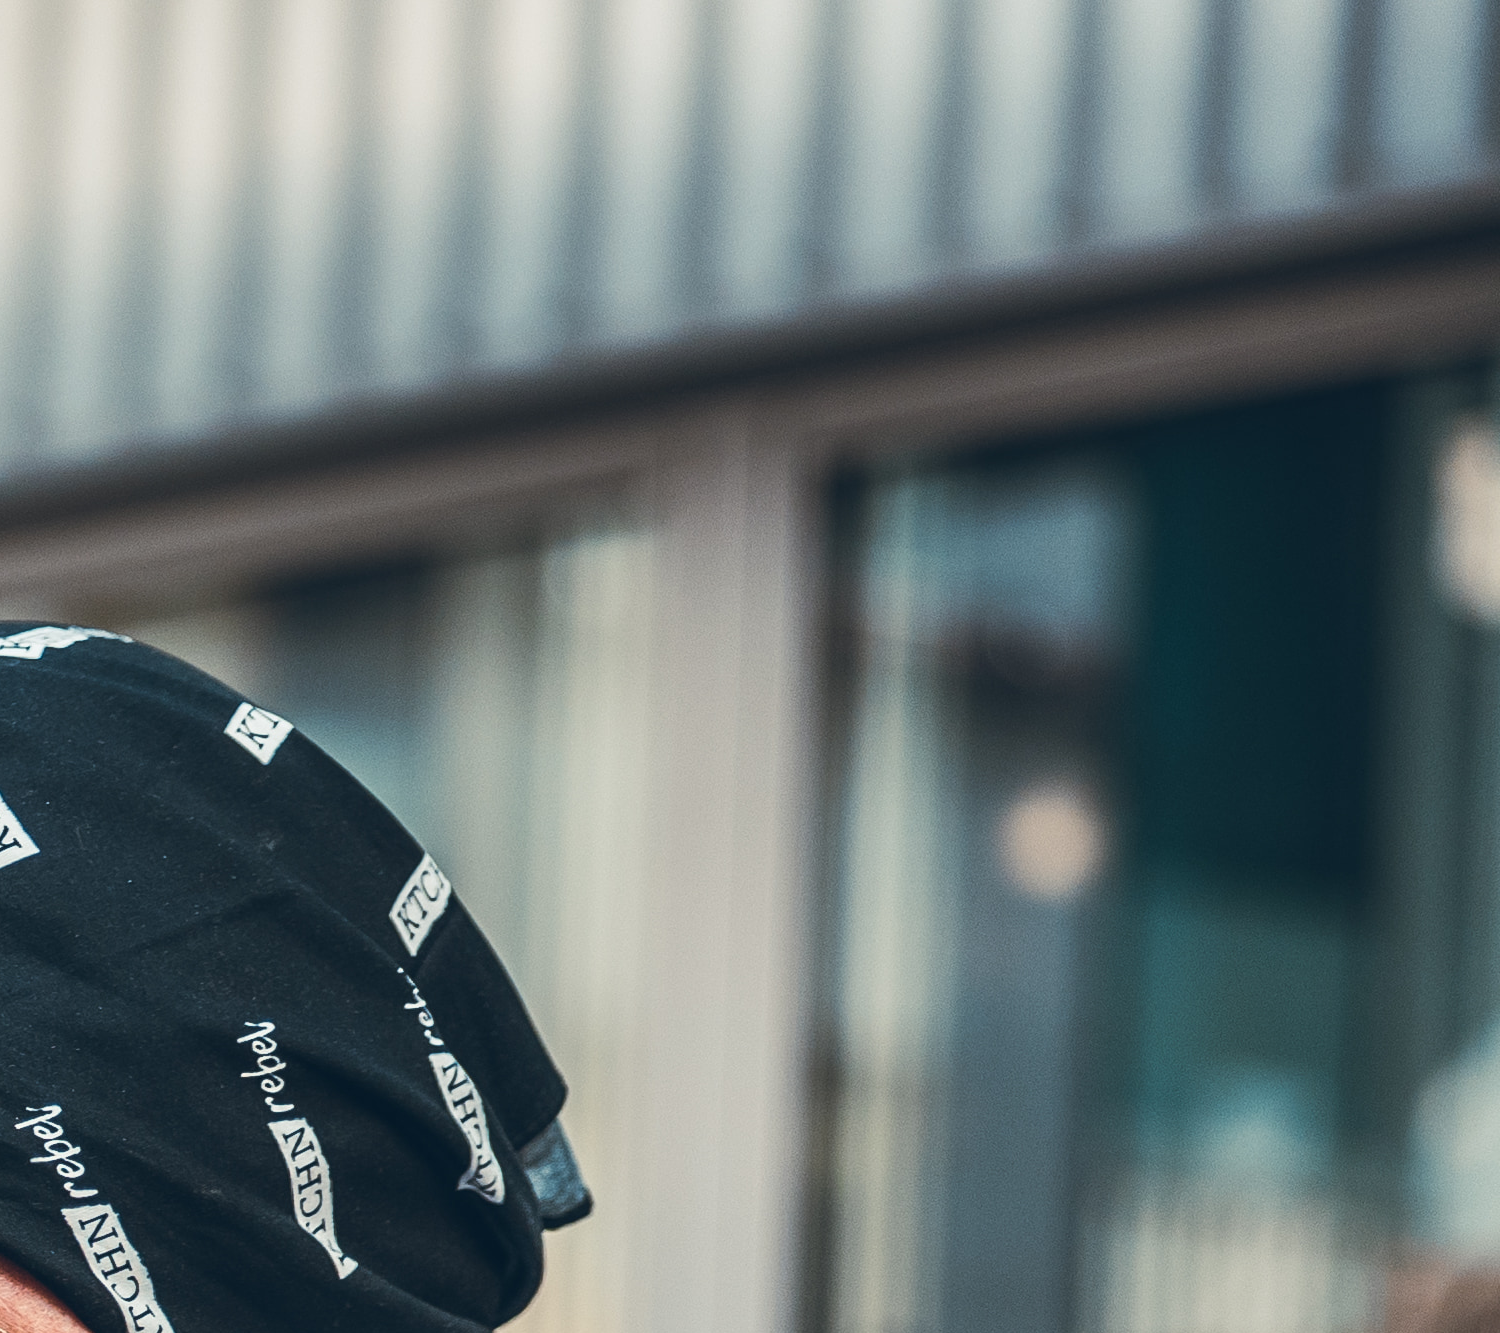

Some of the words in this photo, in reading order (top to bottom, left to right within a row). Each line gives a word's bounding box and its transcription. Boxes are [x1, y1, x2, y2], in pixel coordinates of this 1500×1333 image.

[236, 1021, 295, 1113] rebel
[14, 1103, 99, 1199] rebel
[282, 1126, 348, 1266] CHN
